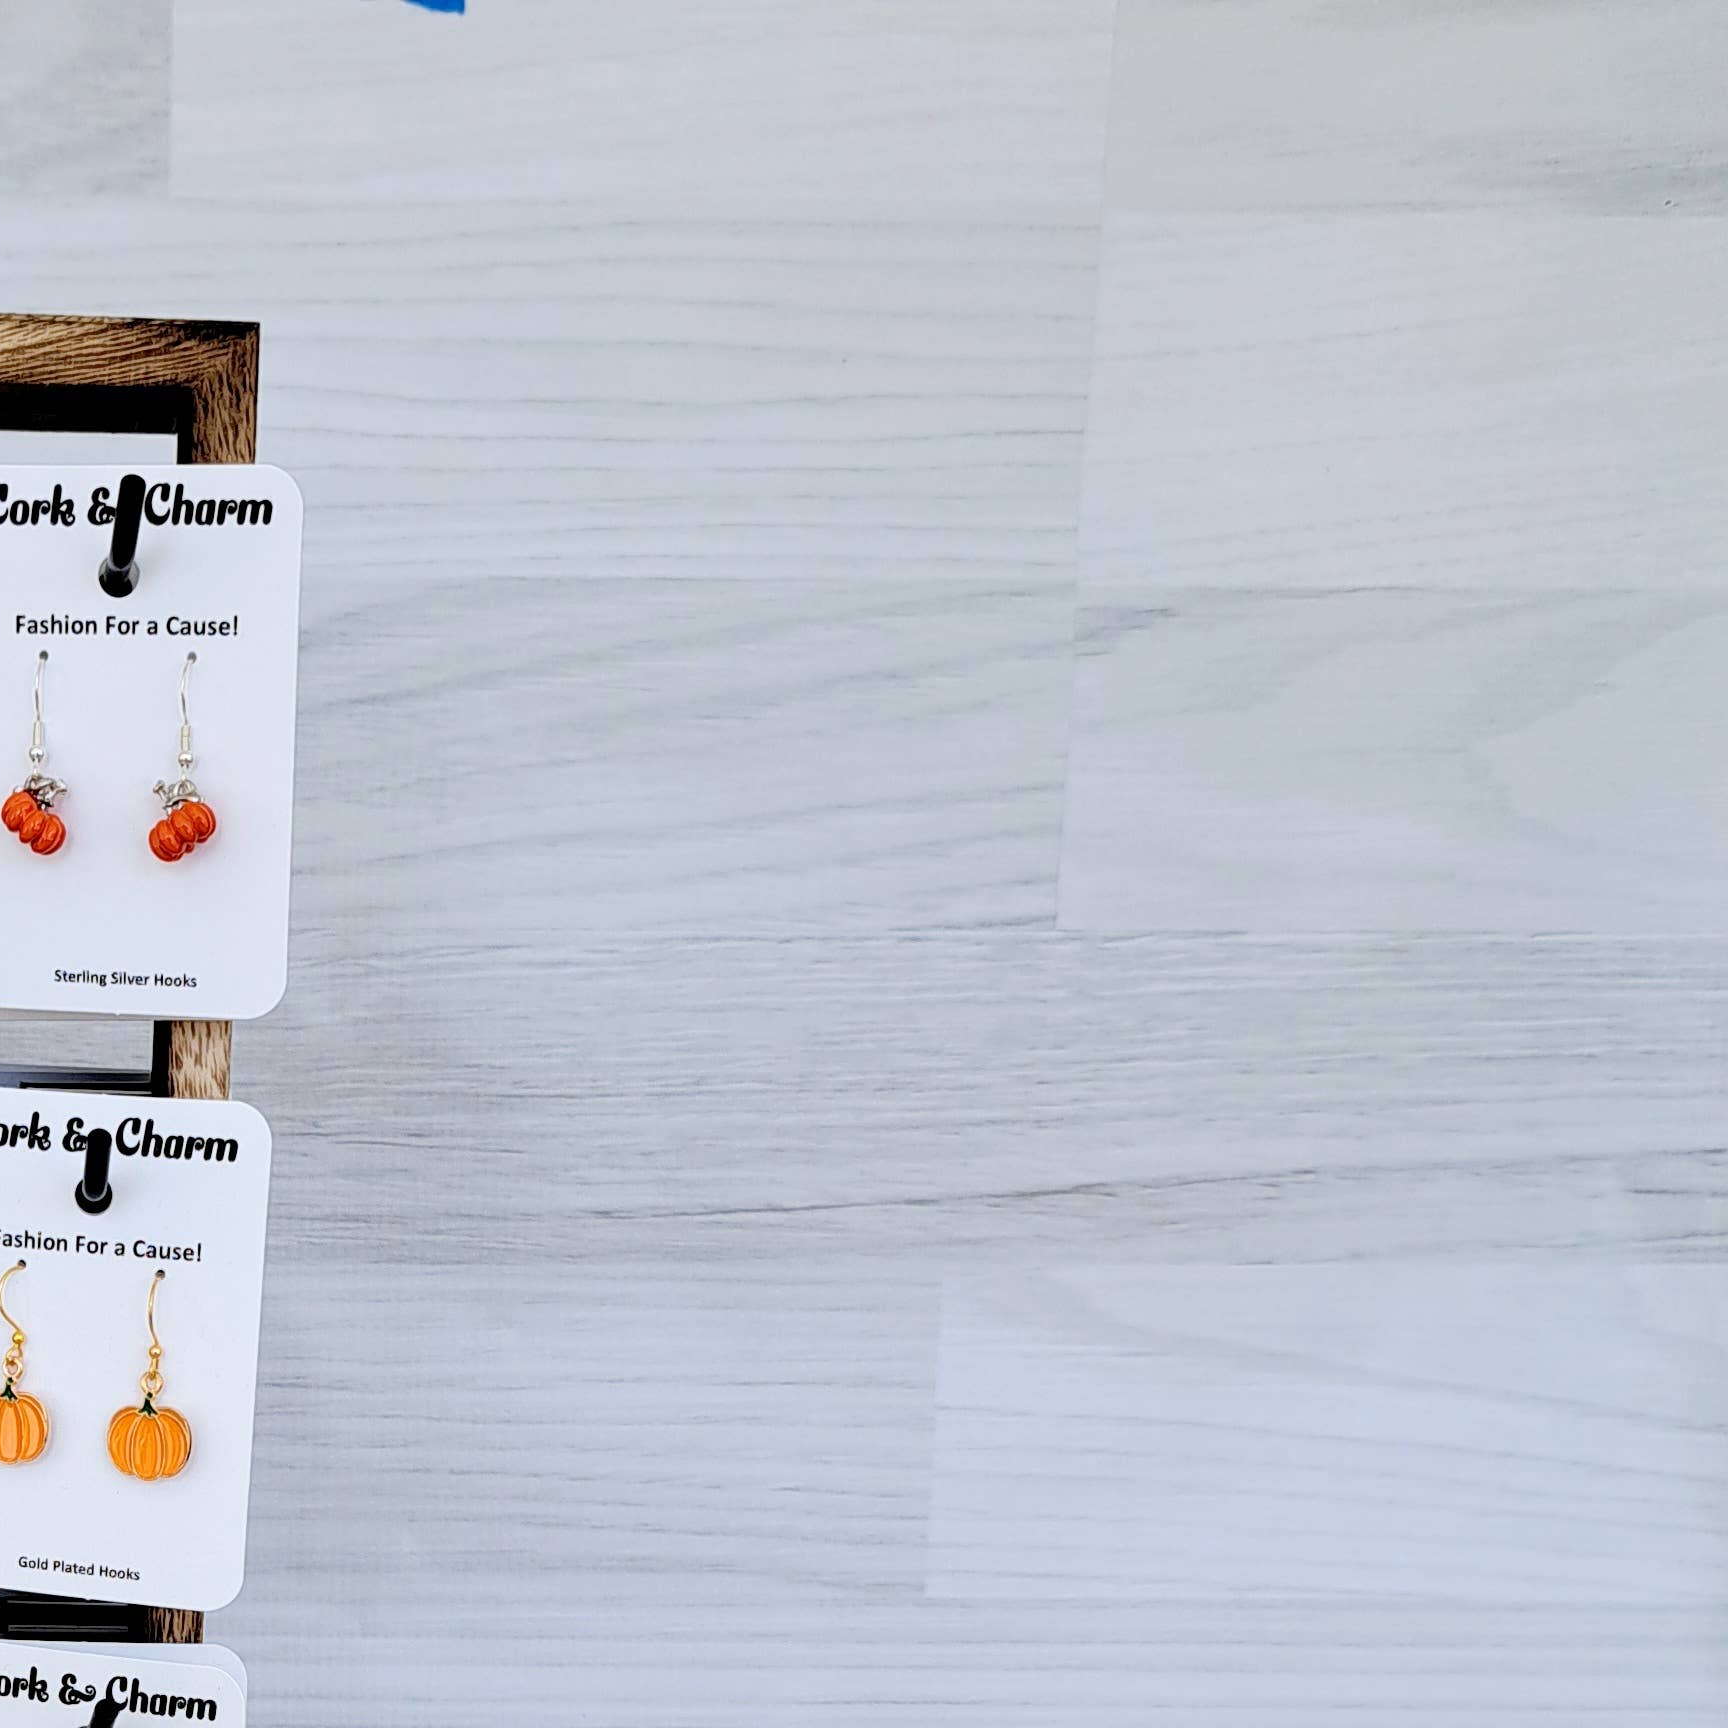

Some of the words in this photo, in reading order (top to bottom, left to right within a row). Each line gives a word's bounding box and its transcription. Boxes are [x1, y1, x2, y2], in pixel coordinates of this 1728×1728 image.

[141, 480, 274, 527] Charm
[15, 613, 98, 635] Fashion
[105, 615, 140, 636] For
[146, 620, 158, 636] a
[165, 615, 238, 637] Cause!
[54, 969, 108, 987] Sterling
[110, 971, 150, 986] Silver
[154, 973, 198, 988] Hooks
[115, 1117, 239, 1163] Charm
[75, 1235, 109, 1255] For
[114, 1242, 126, 1257] a
[132, 1239, 202, 1263] Cause!
[18, 1556, 49, 1571] Gold
[53, 1560, 95, 1576] Plated
[99, 1565, 140, 1581] Hooks
[58, 1673, 97, 1706] &
[101, 1675, 218, 1725] Charm
